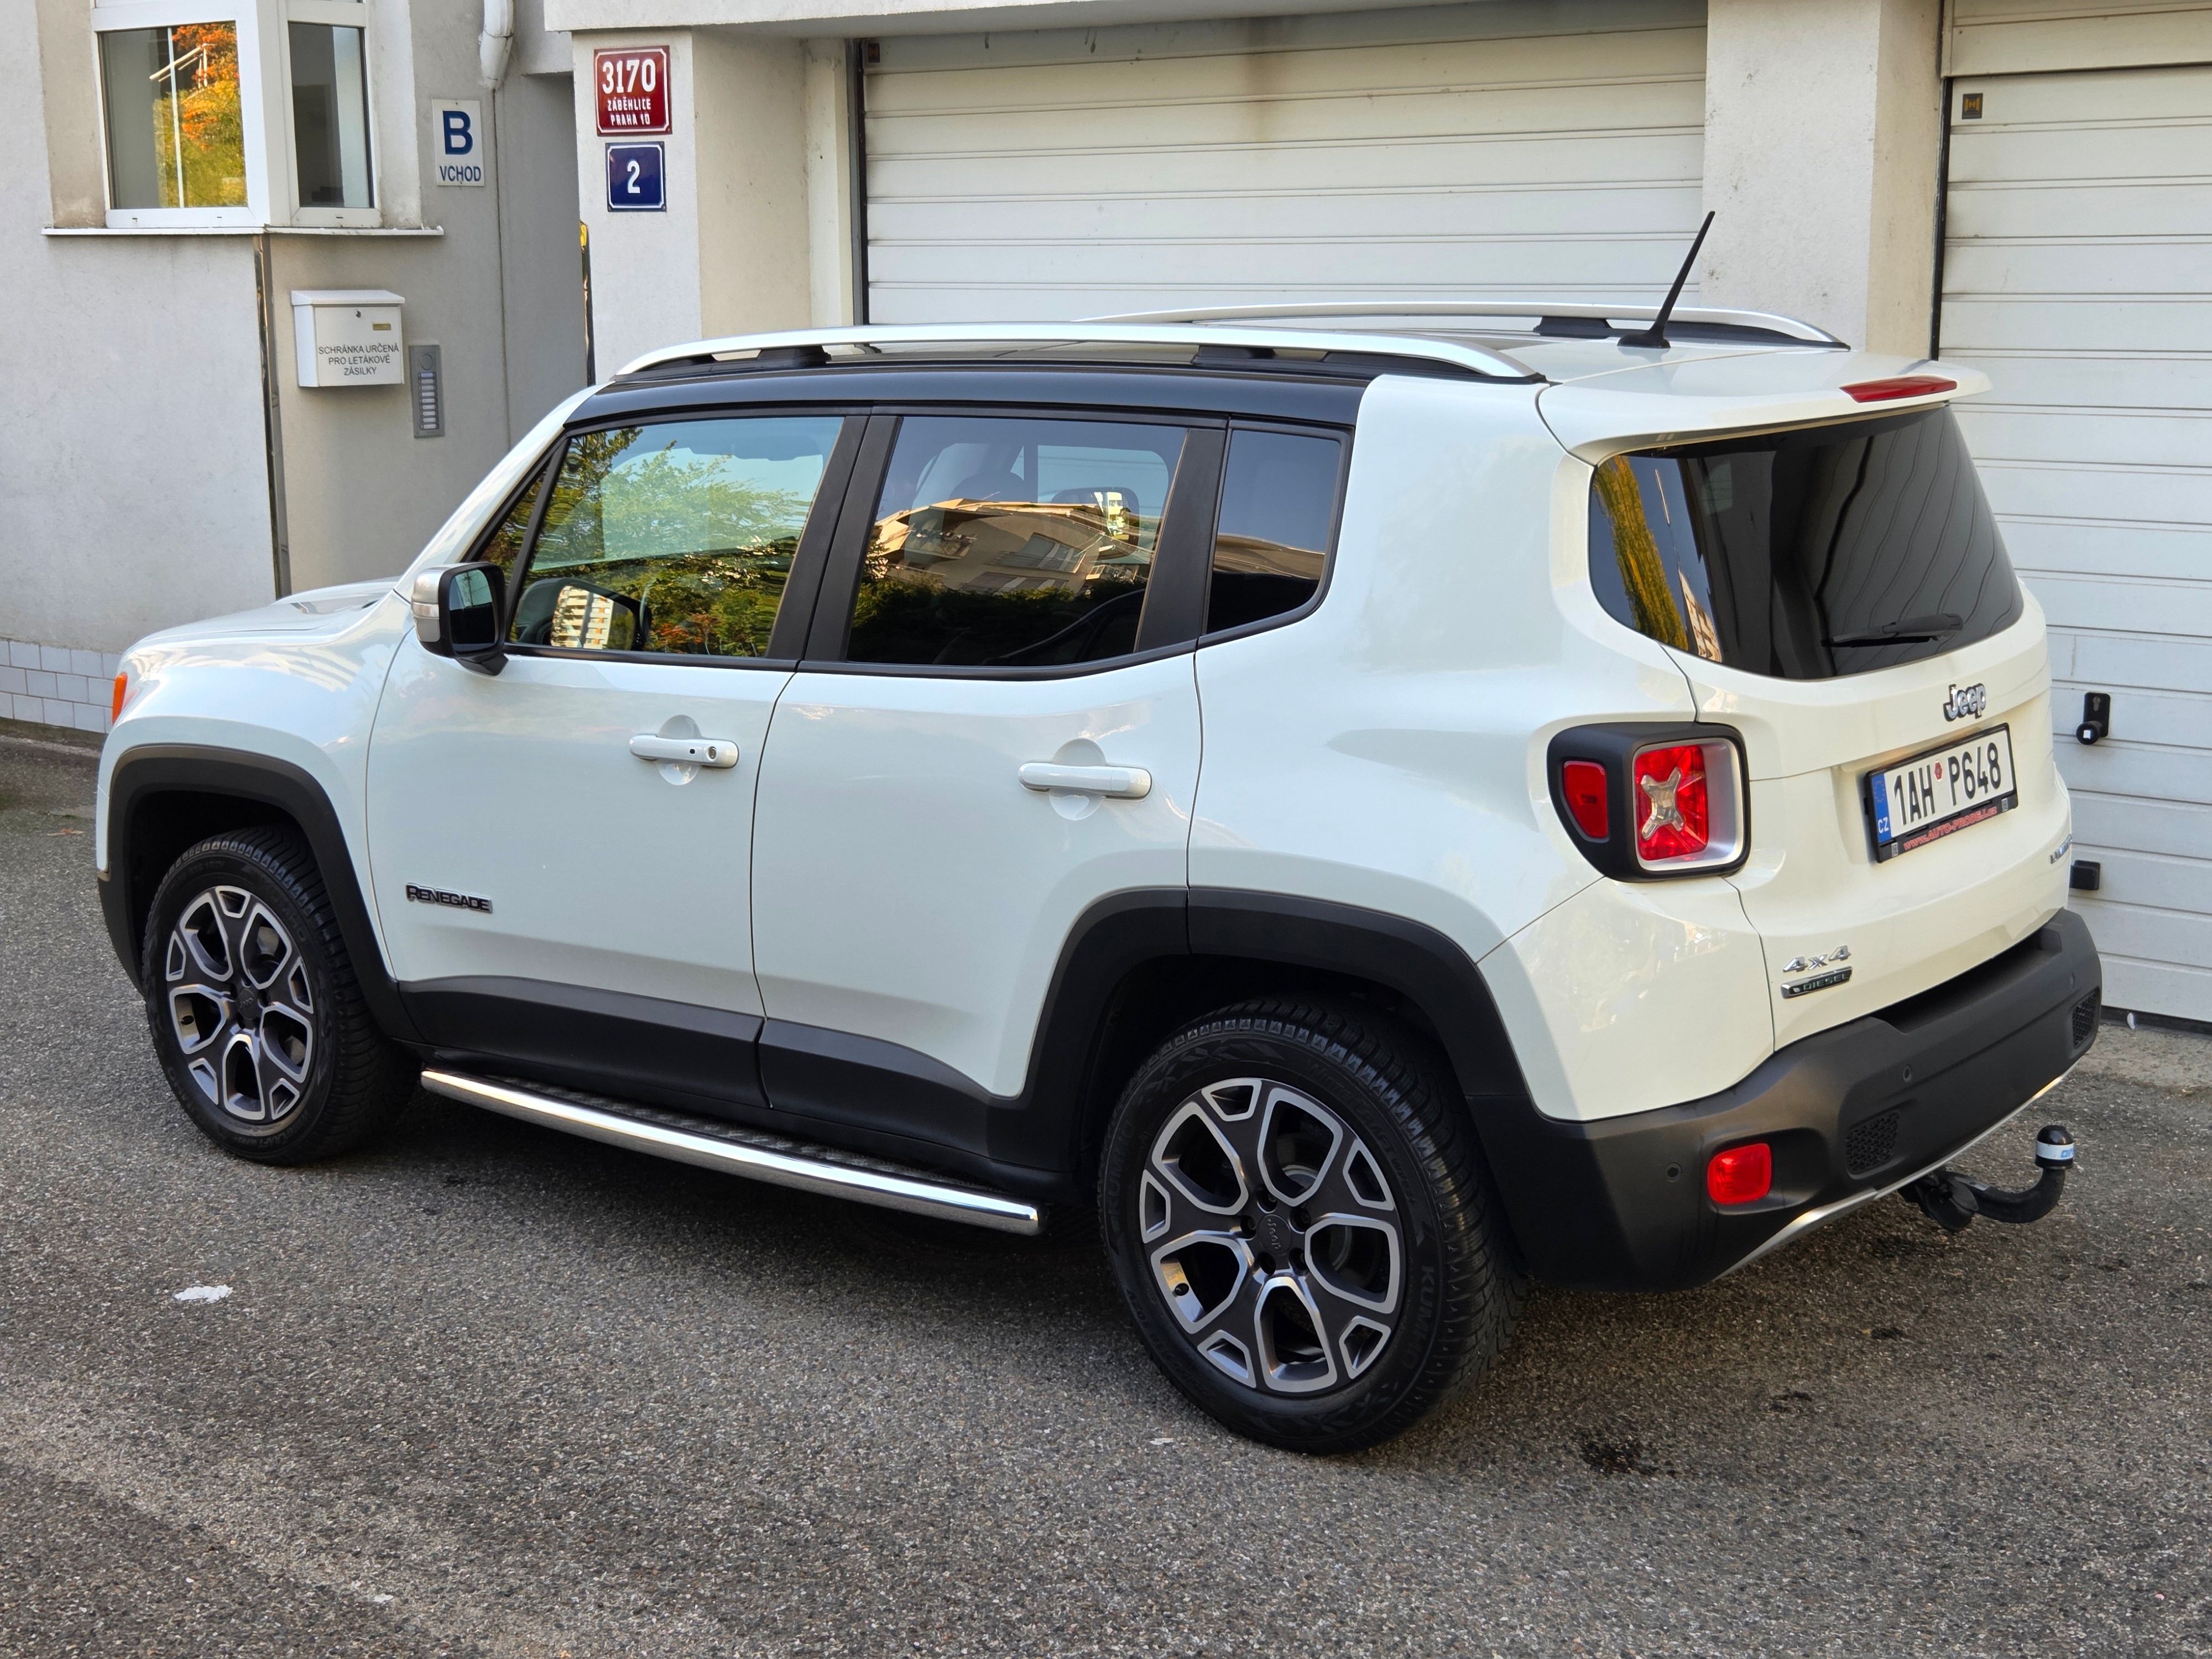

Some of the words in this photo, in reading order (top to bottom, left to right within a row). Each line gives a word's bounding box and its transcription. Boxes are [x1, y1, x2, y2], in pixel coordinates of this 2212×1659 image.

[602, 59, 656, 94] 3170
[608, 96, 651, 111] ZÁBĚHLICE
[611, 114, 638, 126] PRAHA
[640, 113, 650, 125] 10
[442, 111, 473, 155] B
[440, 165, 481, 182] VCHOD
[627, 160, 640, 194] 2
[318, 345, 364, 354] SCHRÁNKA
[366, 343, 399, 353] URČENÁ
[328, 357, 346, 365] PRO
[348, 353, 390, 365] LETÁKOVÉ
[344, 366, 377, 375] ZÁSILKY
[1943, 683, 1986, 721] Jeep
[1893, 764, 1936, 825] 1AH
[1948, 742, 2001, 806] P648
[1877, 817, 1888, 834] CZ
[405, 882, 493, 914] RENEGADE
[1803, 973, 1849, 992] DIESEL
[1400, 1265, 1435, 1369] KUMHO
